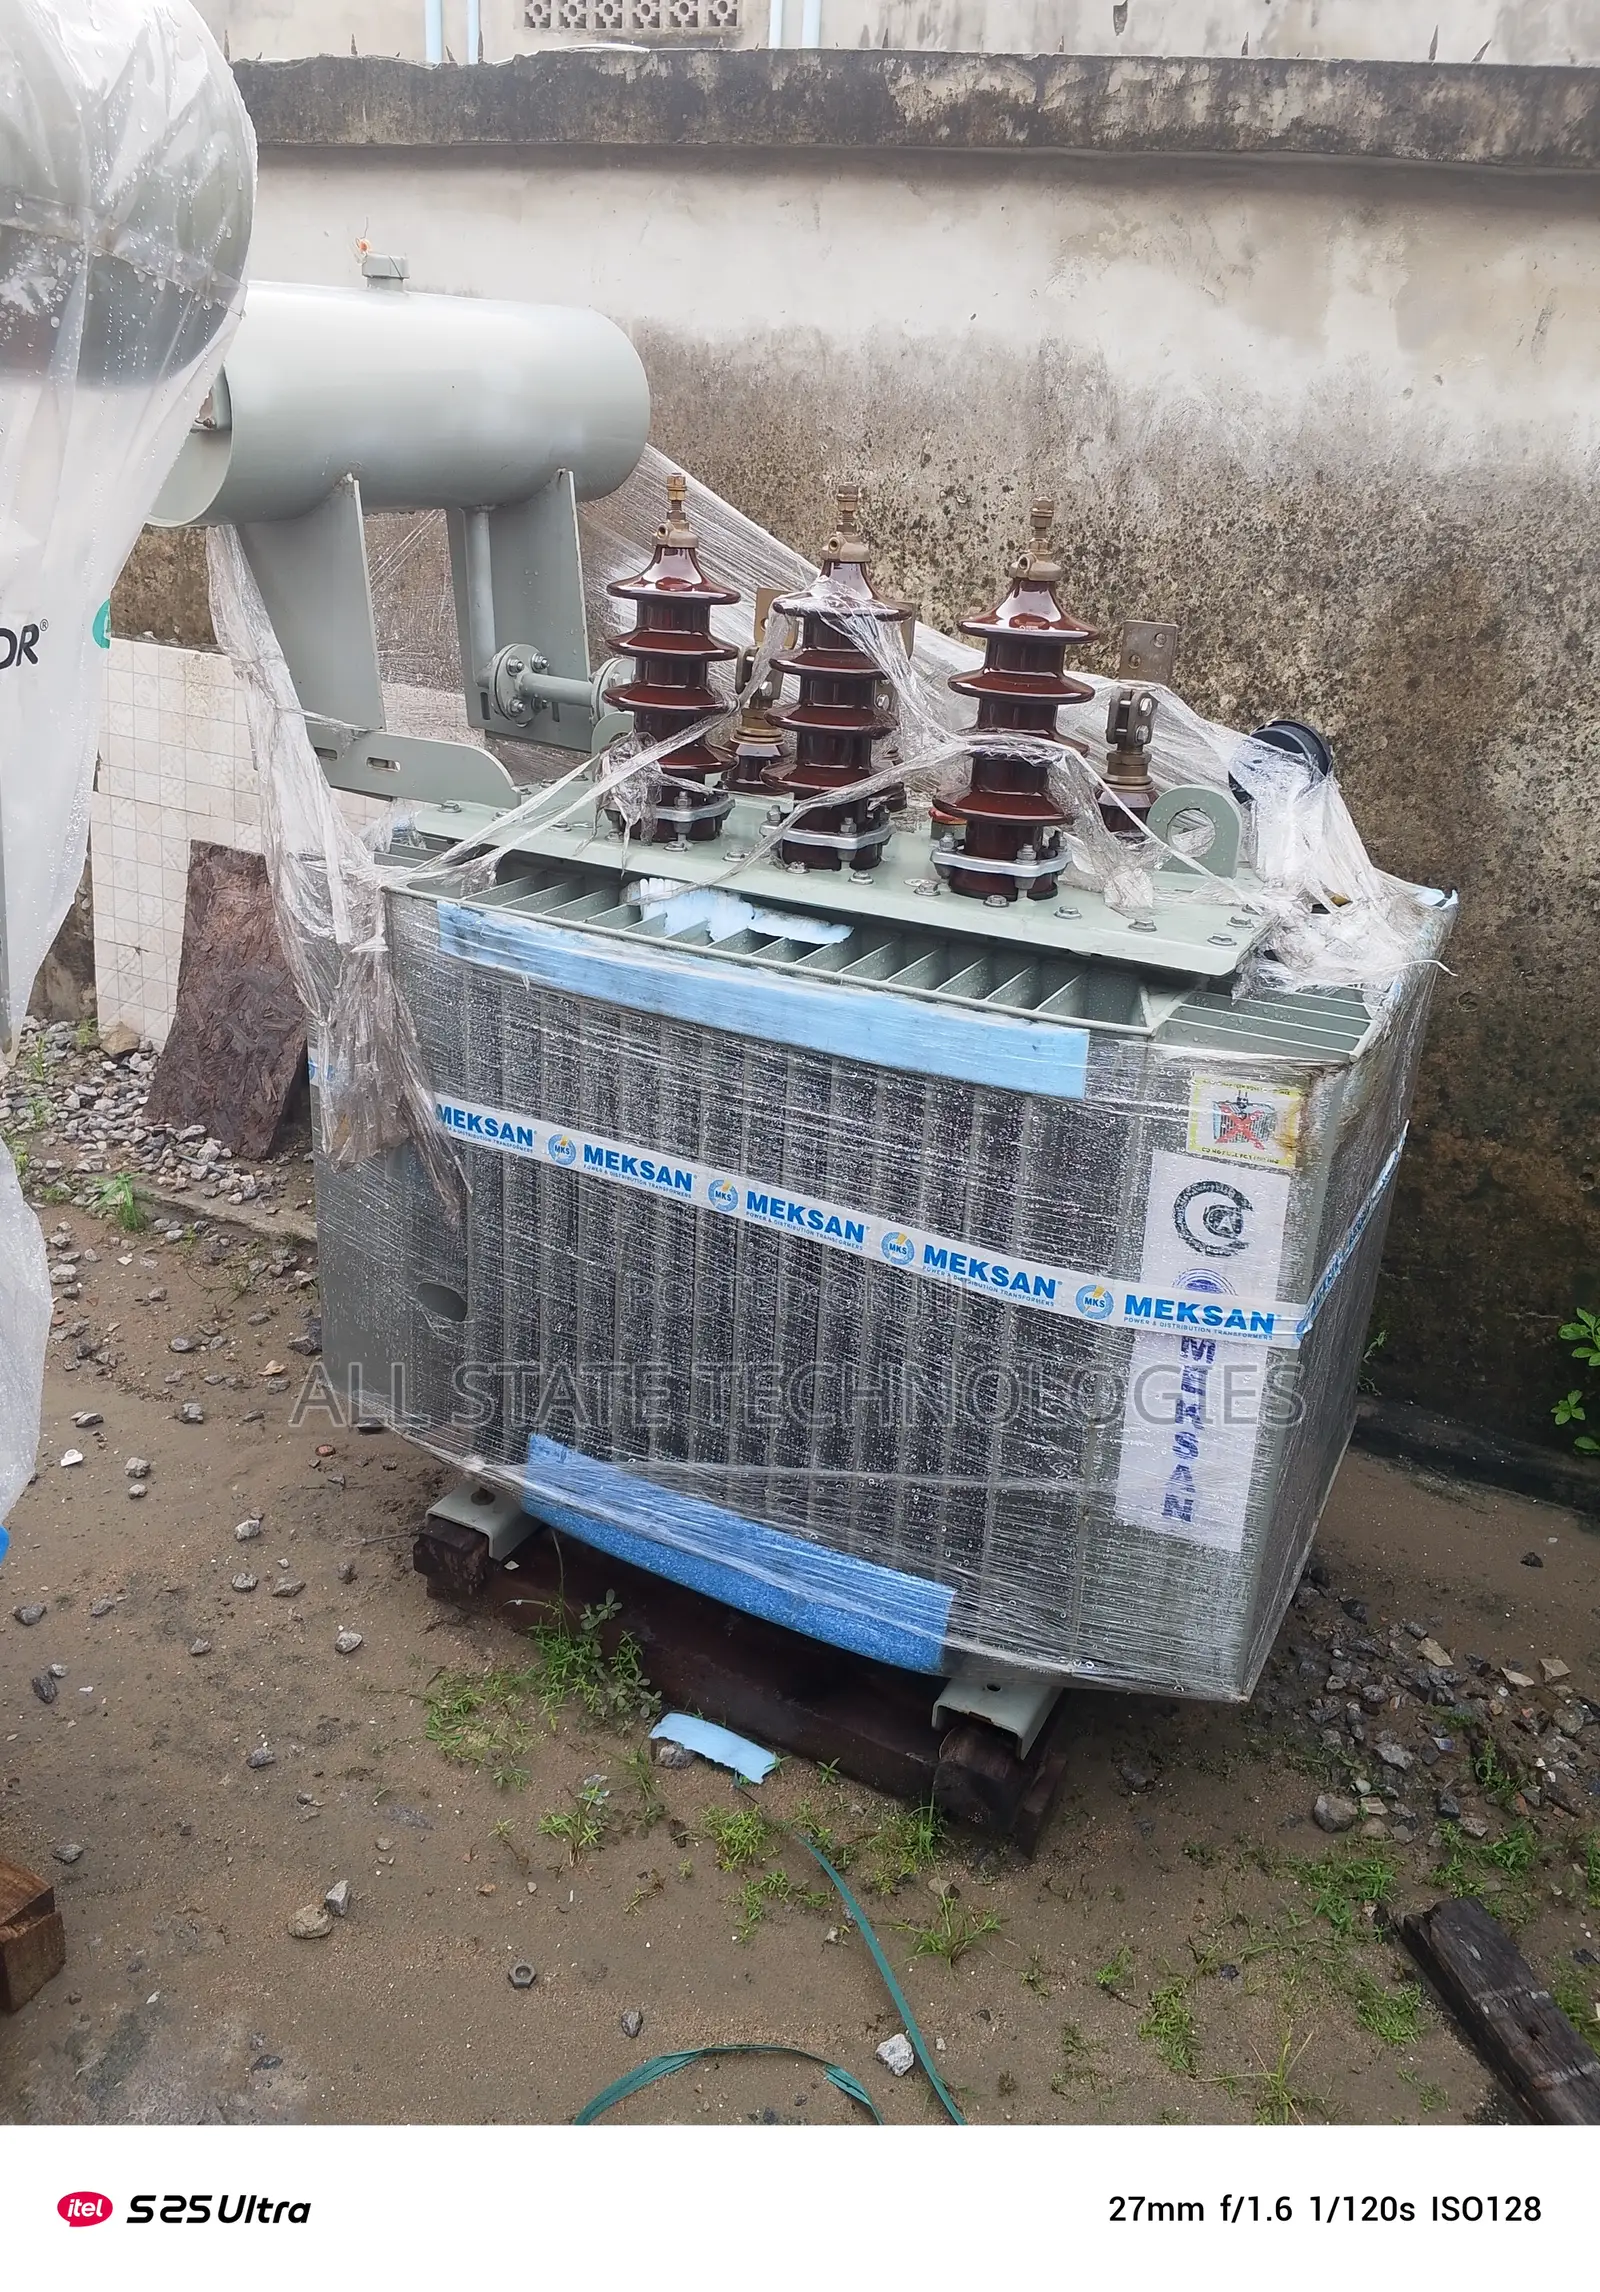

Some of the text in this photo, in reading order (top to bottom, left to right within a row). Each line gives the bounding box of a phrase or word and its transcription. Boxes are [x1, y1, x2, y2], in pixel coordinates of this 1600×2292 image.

[435, 1104, 534, 1147] MEKSAN
[554, 1145, 570, 1155] MKS
[583, 1144, 693, 1192] MEKSAN
[715, 1191, 732, 1201] MKS
[746, 1190, 865, 1243] MEKSAN
[774, 1219, 815, 1236] DISTRIBUTION
[816, 1232, 864, 1250] TRANSFORMERS
[889, 1243, 907, 1255] MKS
[922, 1266, 945, 1277] POWER
[1000, 1288, 1055, 1307] TRANSFORMERS
[923, 1244, 1057, 1299] MEKSAN
[1084, 1297, 1105, 1308] MKS
[1124, 1294, 1275, 1335] MEKSAN
[1124, 1317, 1150, 1325] POWER
[1159, 1321, 1212, 1333] DISTRIBUTION
[1213, 1329, 1273, 1341] TRANSFORMERS
